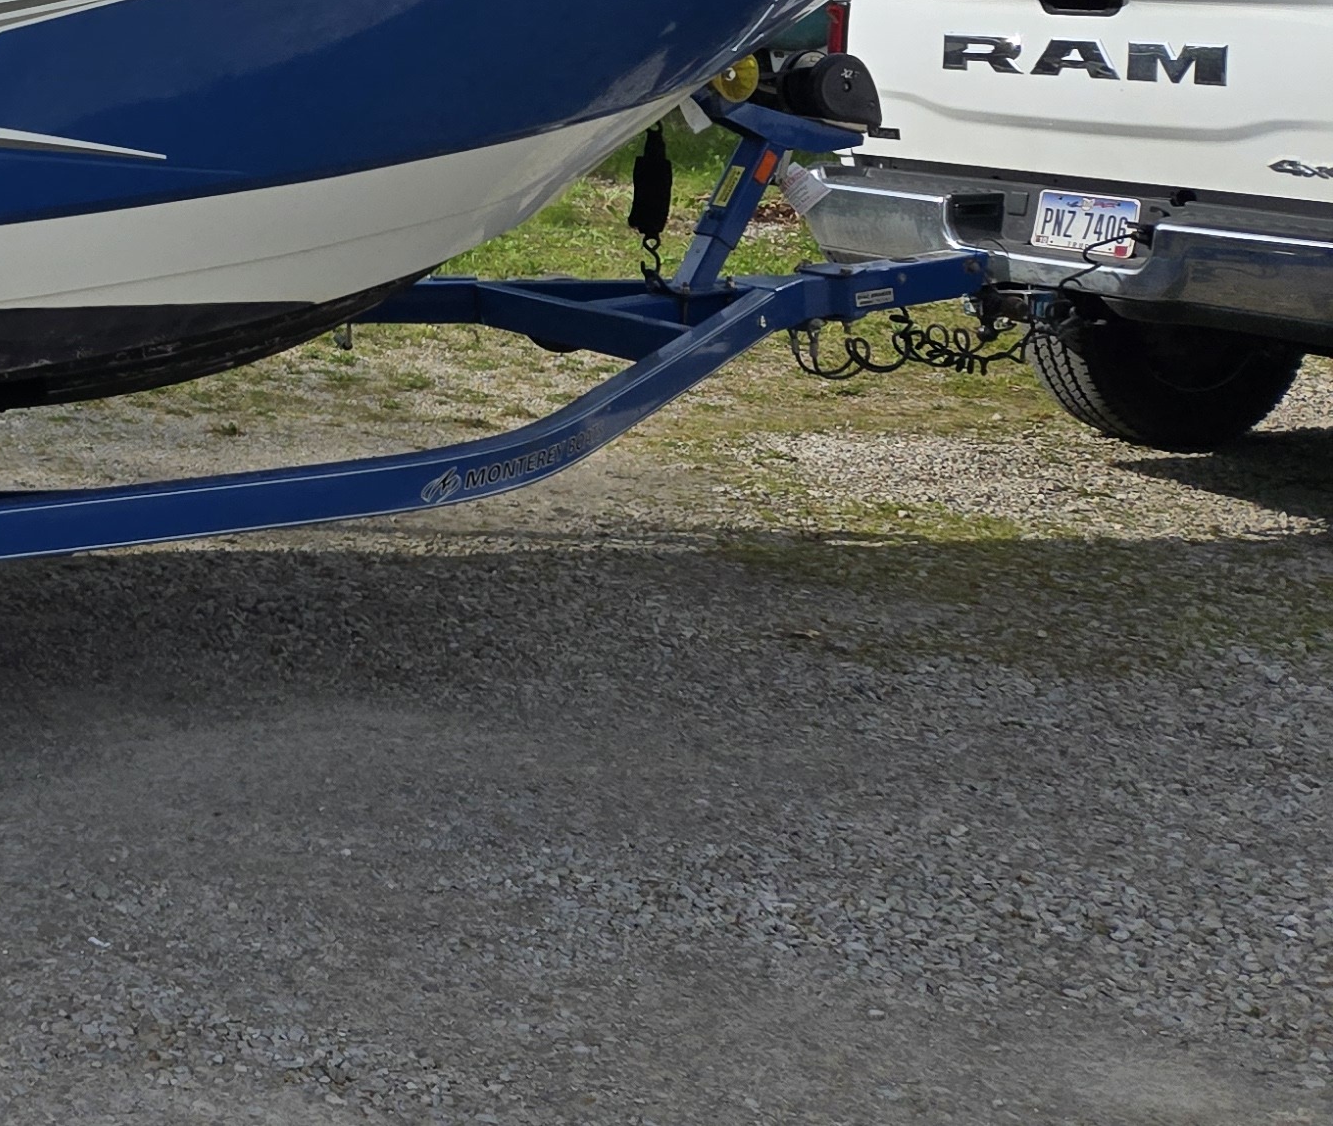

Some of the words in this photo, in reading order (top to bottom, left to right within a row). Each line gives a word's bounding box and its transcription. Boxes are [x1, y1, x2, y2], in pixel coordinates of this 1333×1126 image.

[942, 33, 1228, 86] RAM
[1041, 207, 1076, 238] PNZ
[1082, 212, 1129, 244] 7406
[464, 440, 567, 490] MONTEREY
